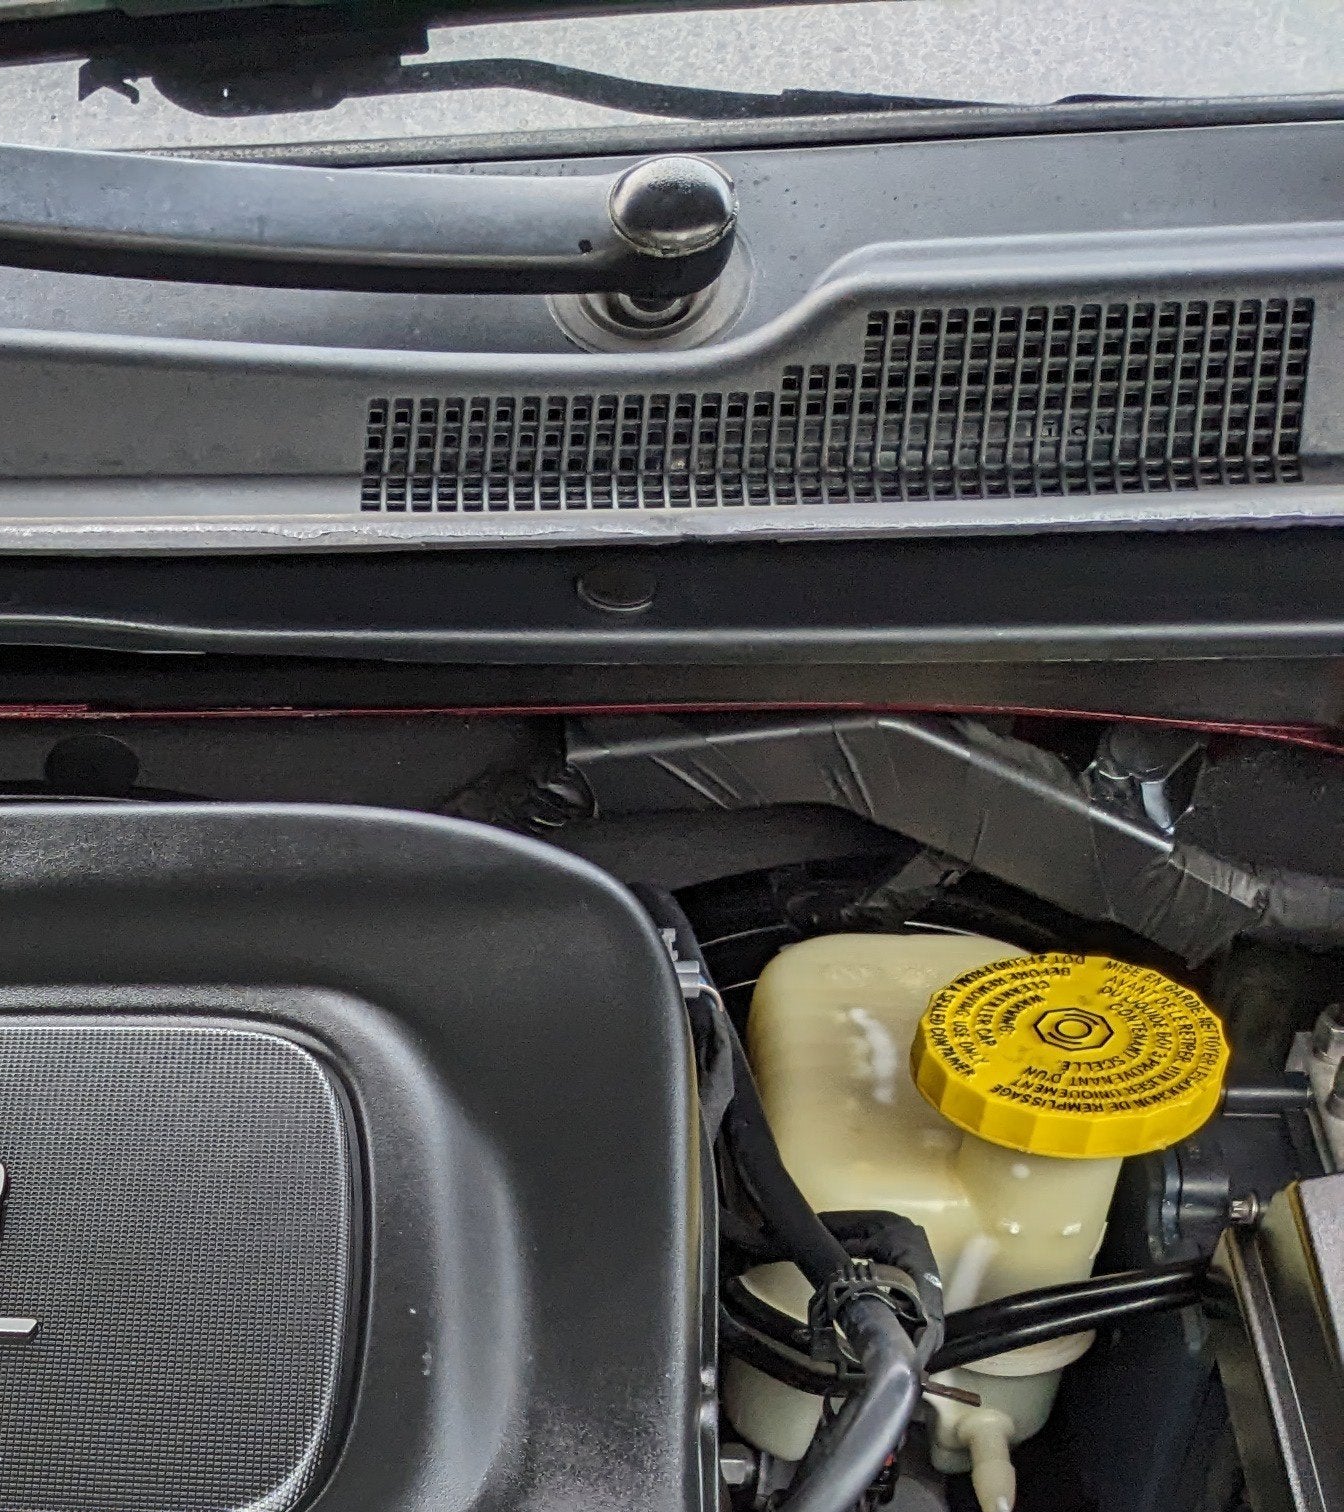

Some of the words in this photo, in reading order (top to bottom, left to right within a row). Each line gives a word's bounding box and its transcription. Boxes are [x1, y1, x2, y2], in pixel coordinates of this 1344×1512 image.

[1054, 955, 1086, 964] DOT
[1104, 961, 1142, 977] MISE
[1107, 976, 1159, 998] AVANT
[1143, 973, 1166, 986] EN
[1097, 985, 1122, 997] DU
[1124, 996, 1169, 1028] LIQUIDE
[1108, 1003, 1148, 1059] CONTENANT
[1070, 1058, 1160, 1086] PROVENANT
[990, 1083, 1104, 1113] REMPLISSAGE
[1010, 1078, 1128, 1100] UNIQUEMENT
[1110, 1102, 1131, 1111] DE
